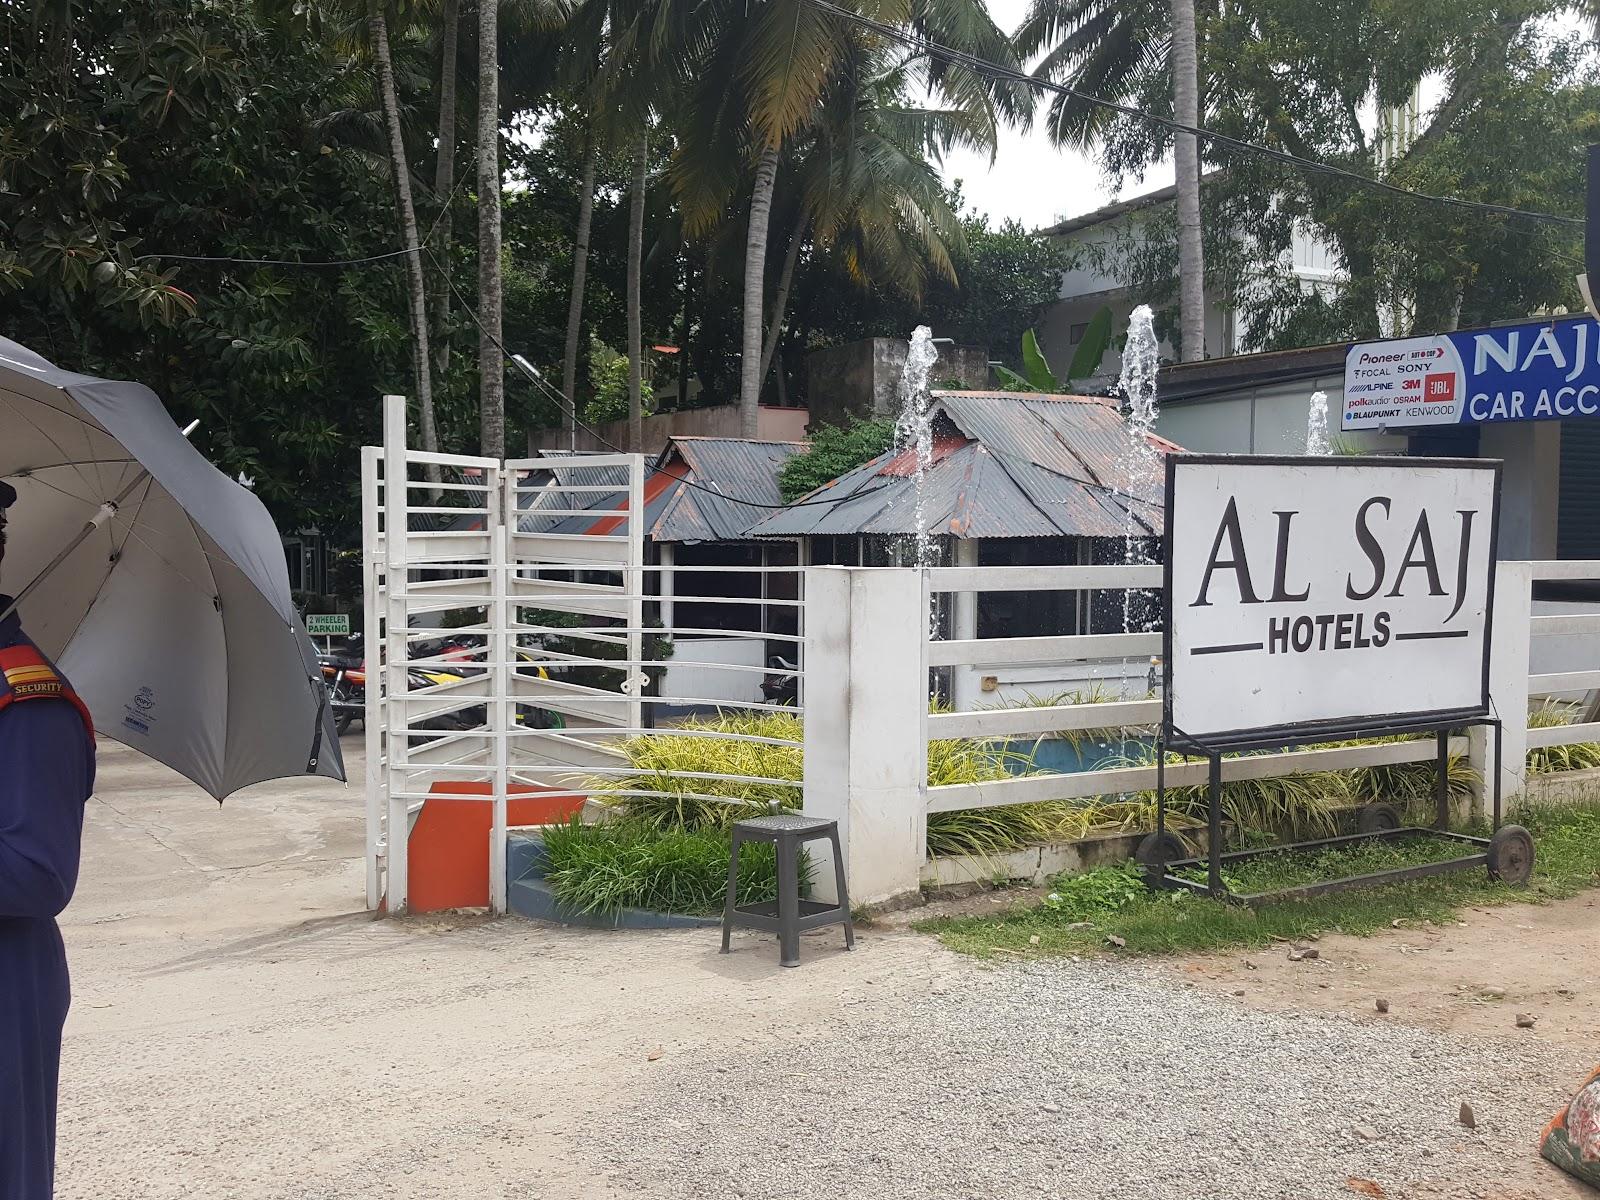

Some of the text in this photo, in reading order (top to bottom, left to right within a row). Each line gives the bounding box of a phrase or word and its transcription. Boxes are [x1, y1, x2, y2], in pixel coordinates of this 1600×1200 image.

[1360, 353, 1405, 365] Pioneer
[1361, 363, 1432, 378] FOCAL SONY
[1362, 379, 1450, 395] ALPINE 3M JBL
[1393, 395, 1421, 405] OSRAM
[1469, 391, 1524, 421] CAR
[1353, 405, 1455, 419] BLAUPUNKT KENWOOD
[1188, 495, 1479, 624] AL SAJ
[309, 615, 346, 624] 2 WHEELER
[308, 624, 348, 633] PARKING
[1268, 611, 1391, 654] HOTELS
[15, 682, 63, 694] SECURITY
